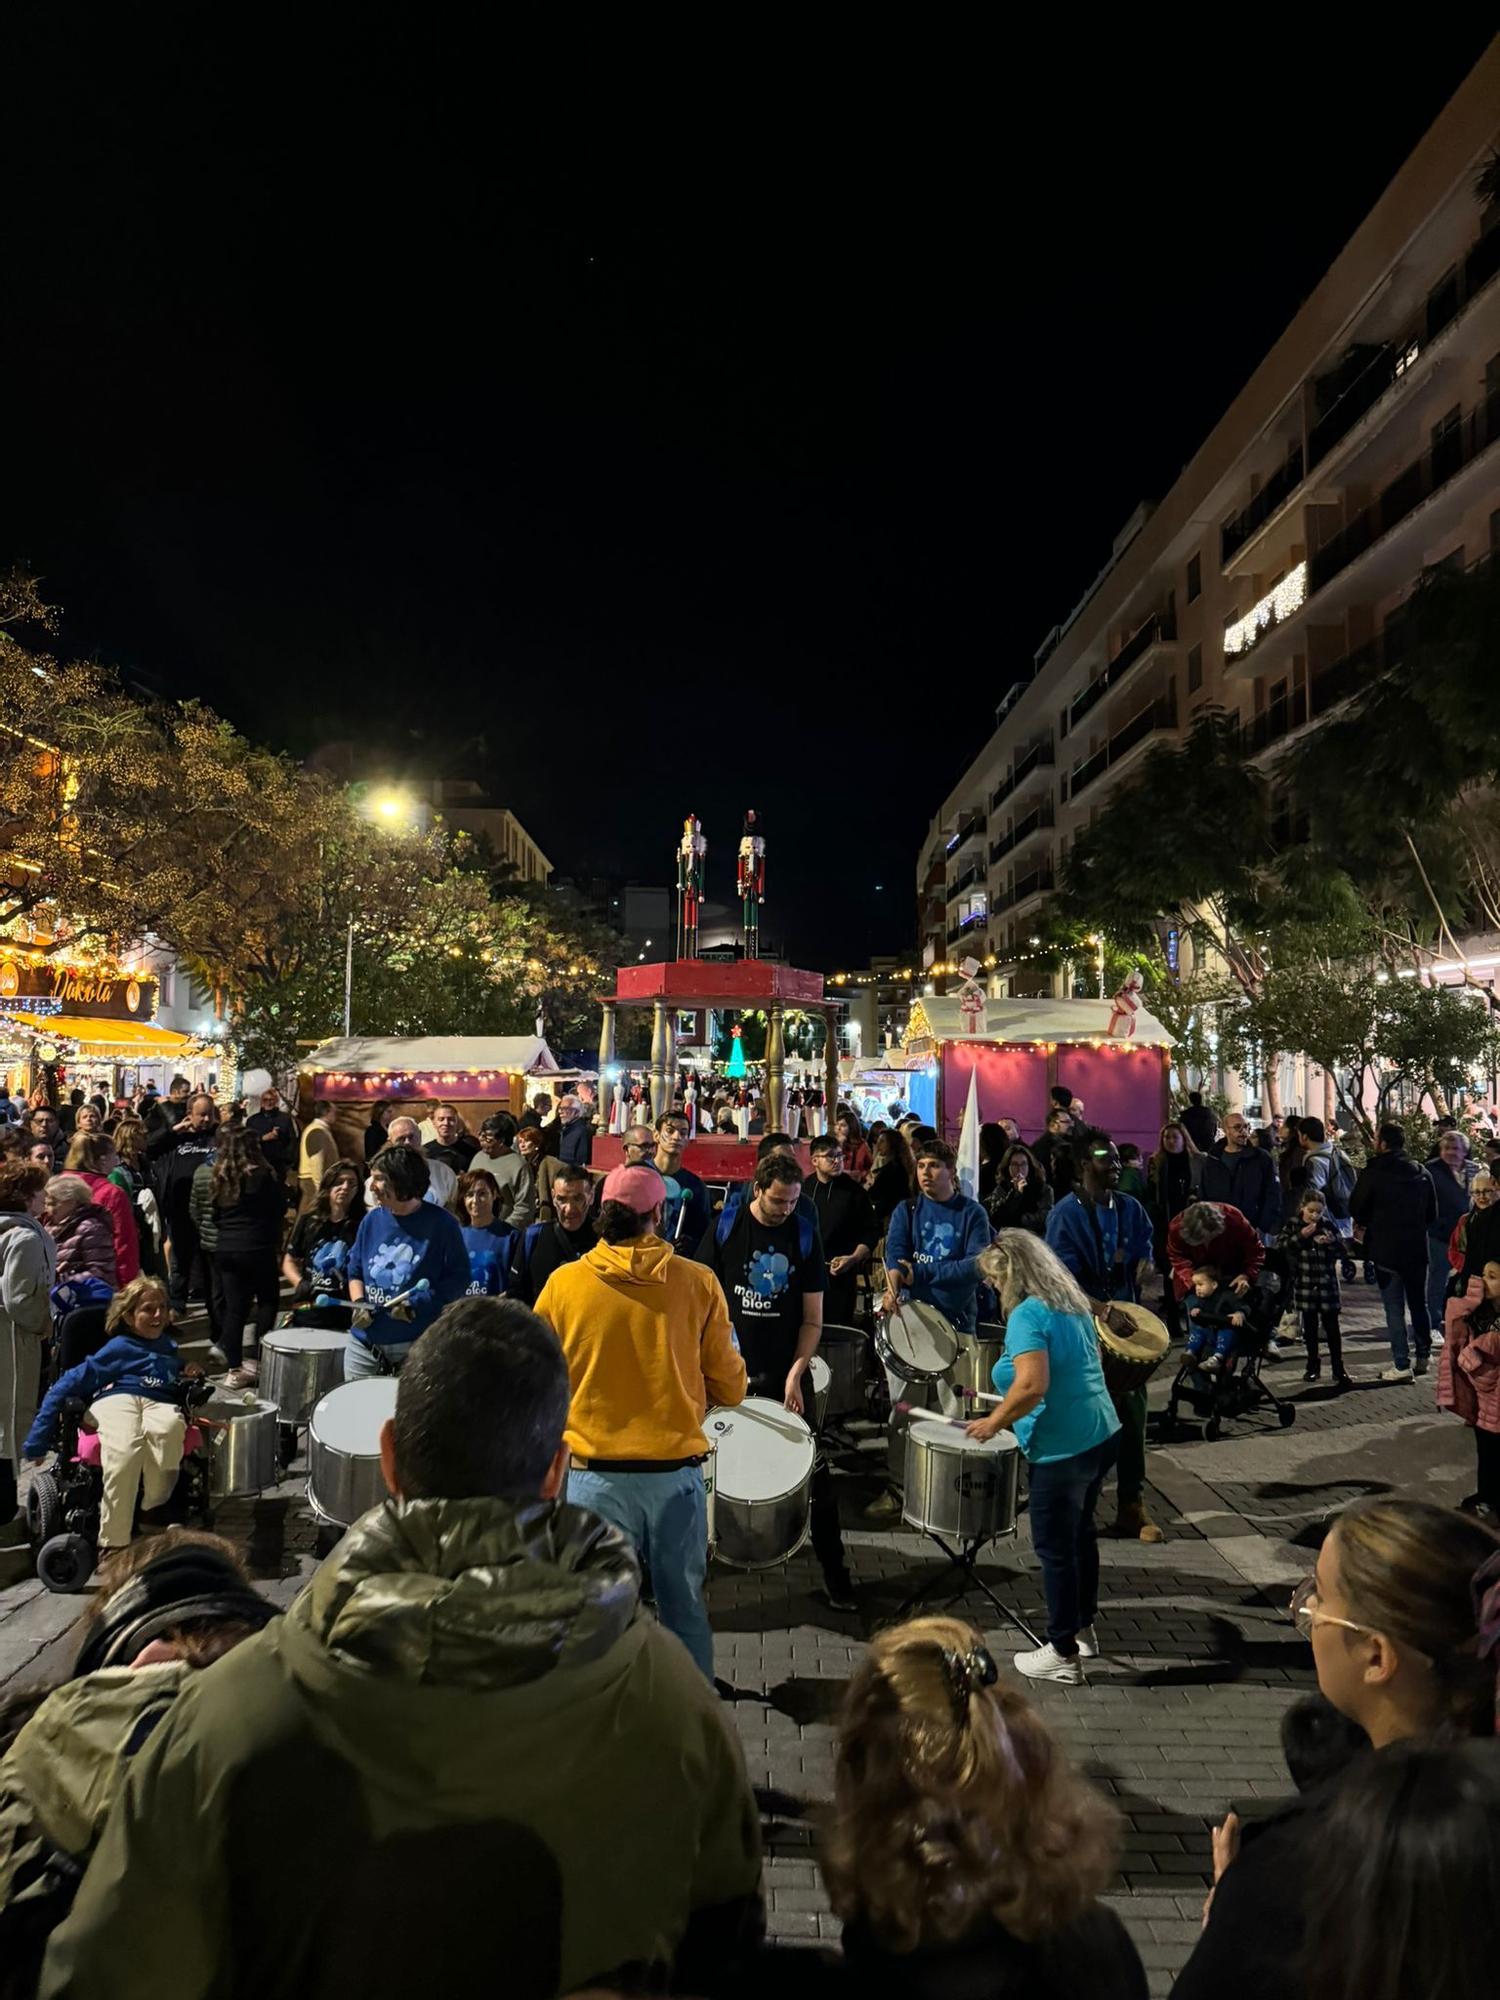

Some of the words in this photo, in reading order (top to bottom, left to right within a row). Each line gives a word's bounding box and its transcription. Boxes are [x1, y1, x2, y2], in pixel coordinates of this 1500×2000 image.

[51, 967, 113, 1003] Dakota
[734, 1284, 762, 1301] mon
[742, 1296, 772, 1309] bloc
